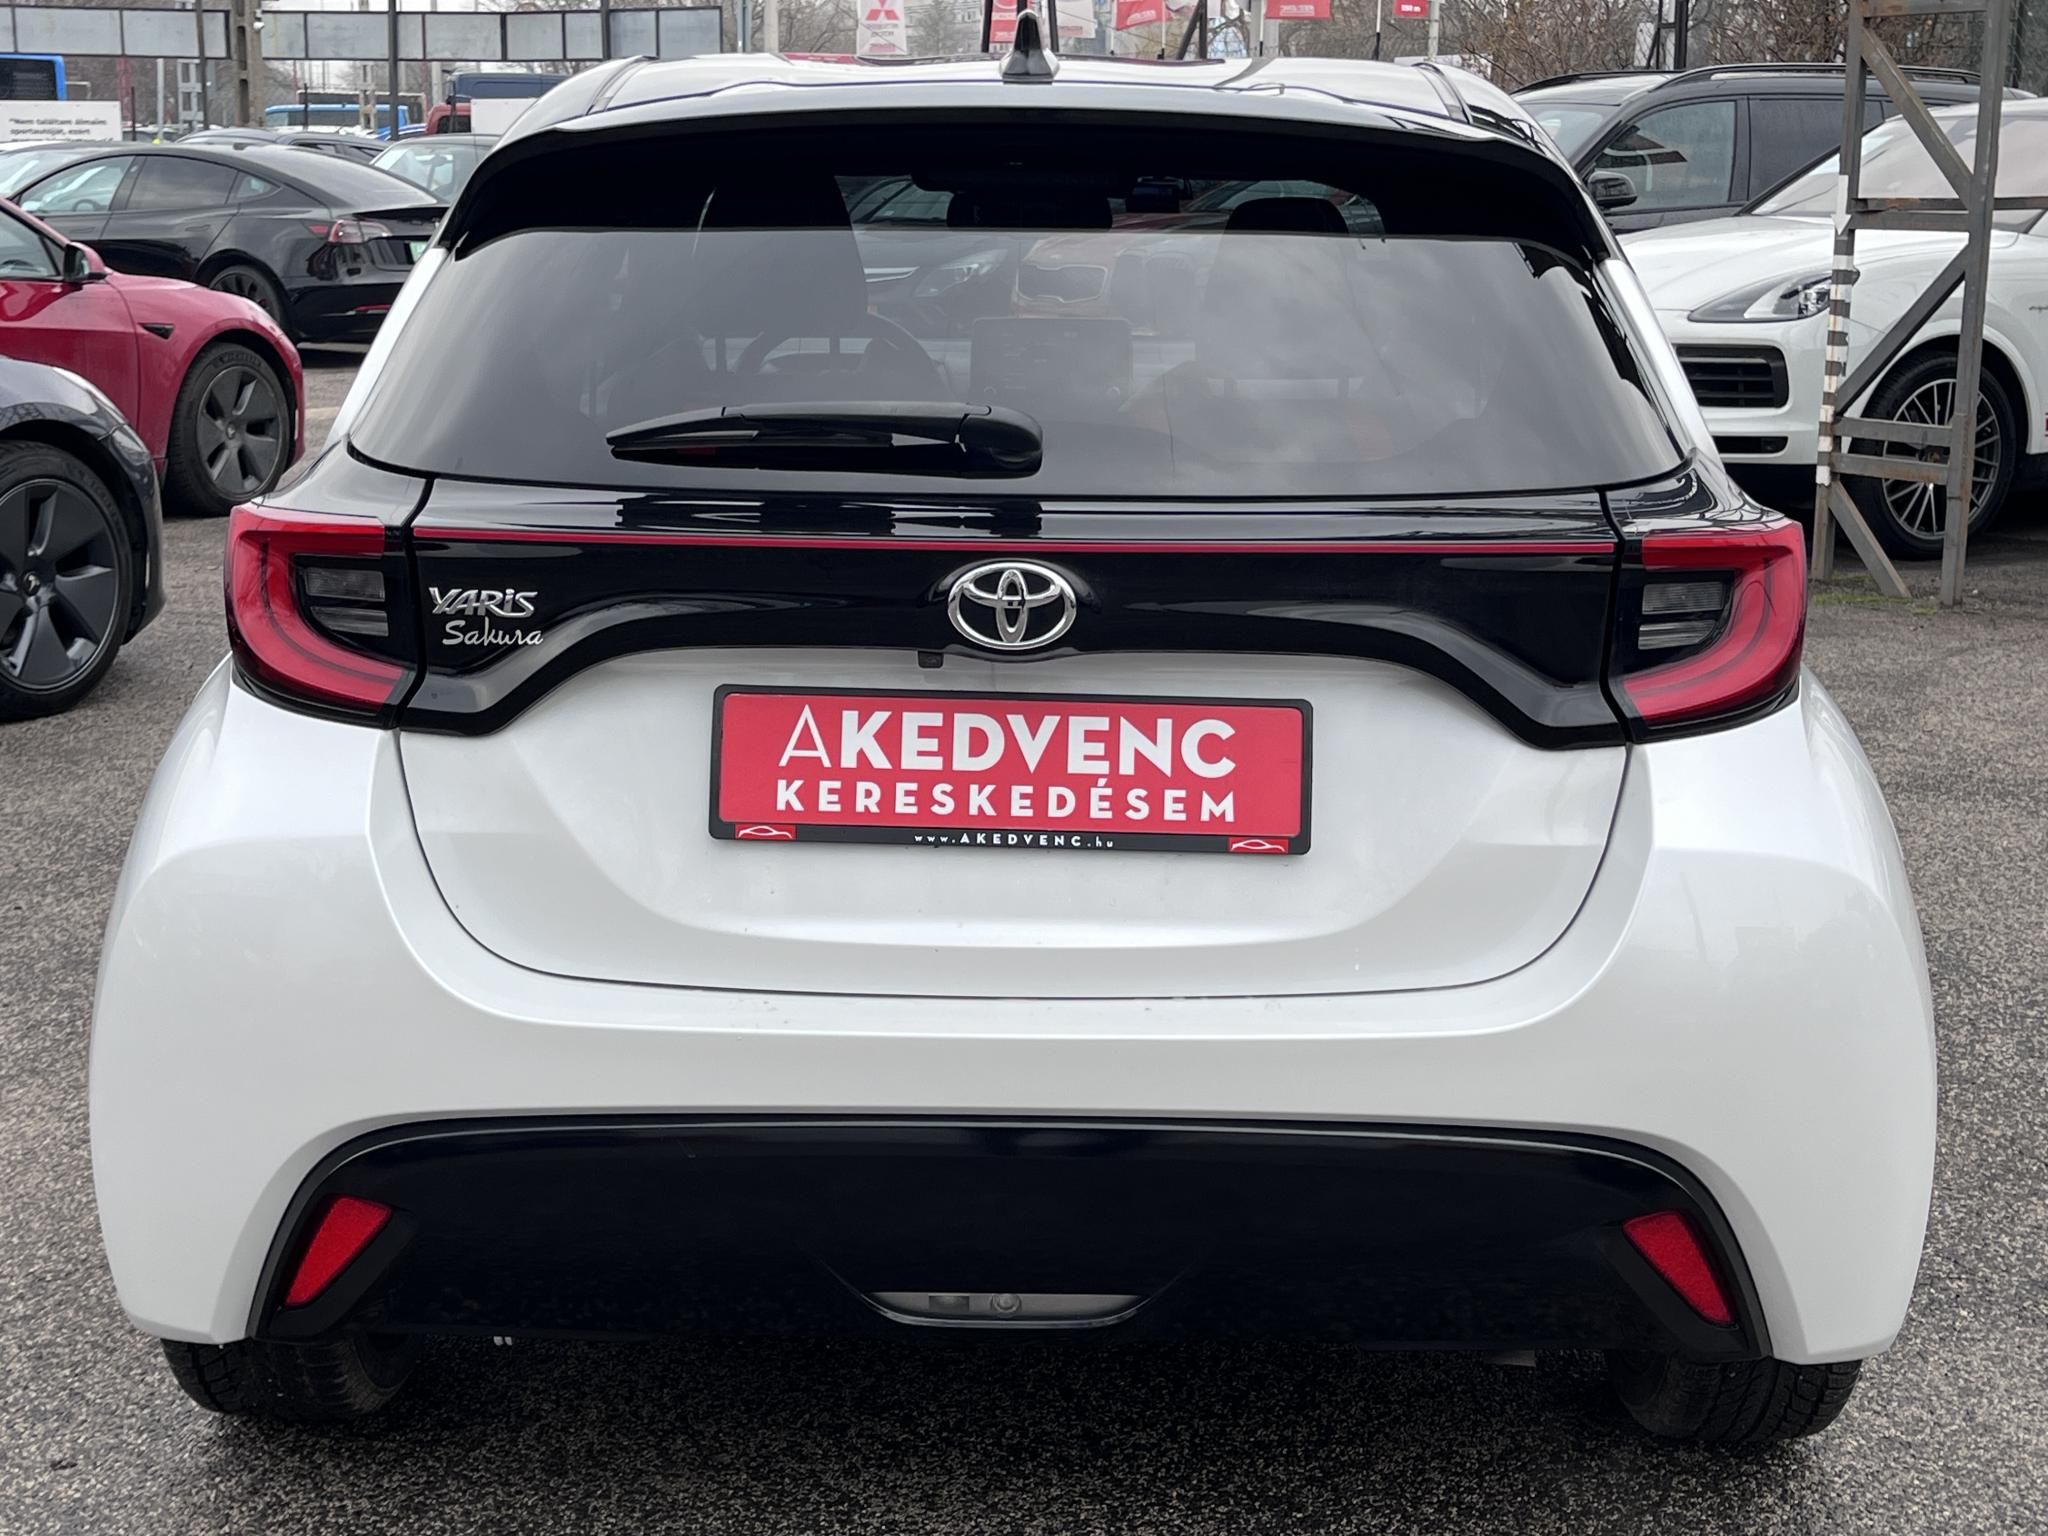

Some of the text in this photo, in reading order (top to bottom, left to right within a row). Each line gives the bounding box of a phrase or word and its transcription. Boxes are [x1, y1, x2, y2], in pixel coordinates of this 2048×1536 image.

[442, 616, 544, 646] Sakura
[778, 704, 1236, 778] AKEDVENC
[776, 778, 1235, 822] KERESKEDÉSEM
[914, 832, 1114, 848] www.AKEDVENC.hu
